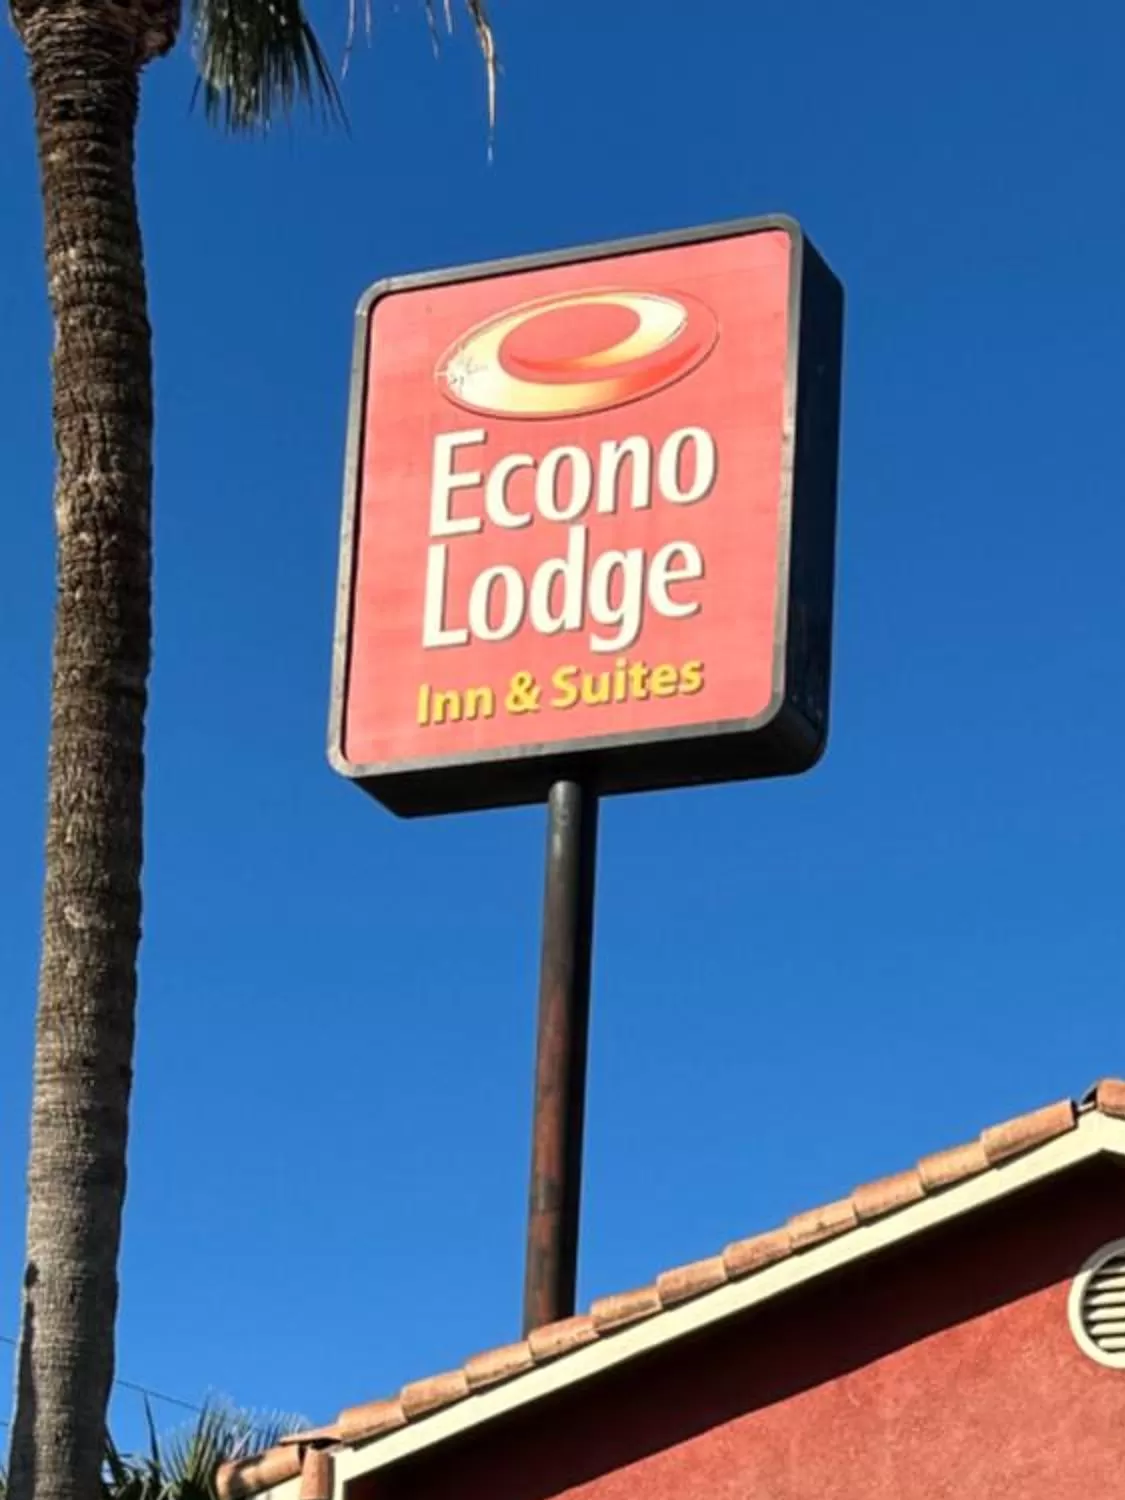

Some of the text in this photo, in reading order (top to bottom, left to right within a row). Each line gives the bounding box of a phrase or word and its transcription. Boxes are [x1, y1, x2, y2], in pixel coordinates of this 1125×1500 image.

[429, 425, 717, 538] Econo
[422, 525, 704, 651] Lodge
[416, 658, 705, 726] Inn & Suites
